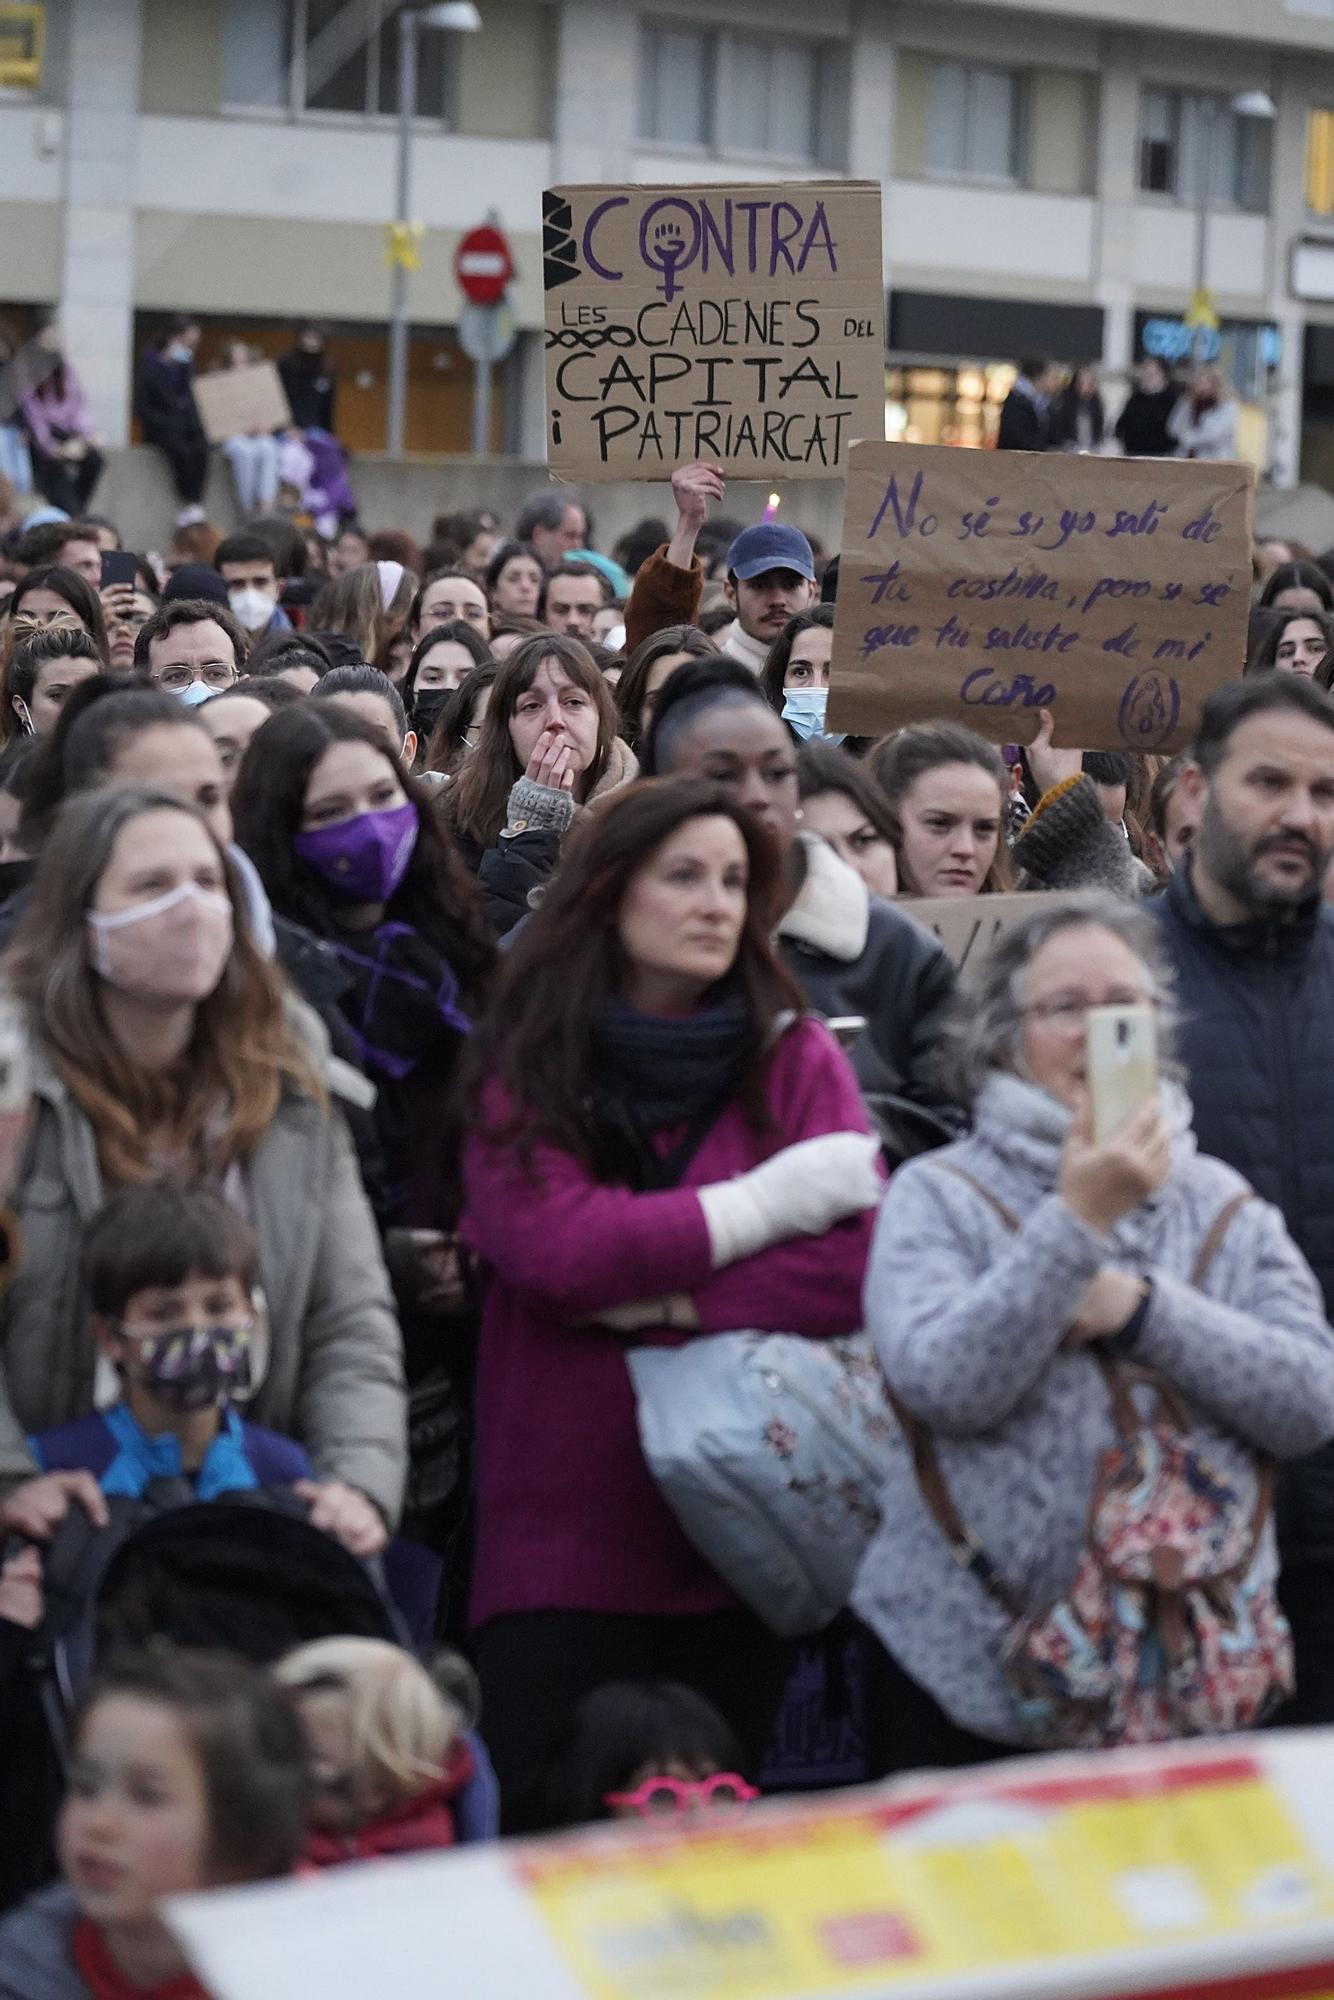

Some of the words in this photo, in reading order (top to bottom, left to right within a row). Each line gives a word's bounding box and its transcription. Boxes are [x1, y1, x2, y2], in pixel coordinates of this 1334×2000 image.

[582, 196, 838, 298] CONTRA
[561, 301, 608, 326] LES
[636, 299, 820, 347] CADENES
[843, 319, 875, 338] DEL
[556, 351, 858, 405] CAPITAL
[590, 405, 852, 466] PATRIARCAT
[867, 470, 938, 539] No
[957, 496, 1000, 540] sé
[1033, 510, 1096, 550] yo
[1105, 500, 1169, 538] salí
[1182, 505, 1222, 543] de
[1081, 578, 1151, 614] pero
[862, 624, 920, 661] que
[984, 618, 1080, 652] saliste
[1102, 622, 1143, 658] de
[1152, 631, 1212, 661] mi
[959, 667, 1057, 707] Coño
